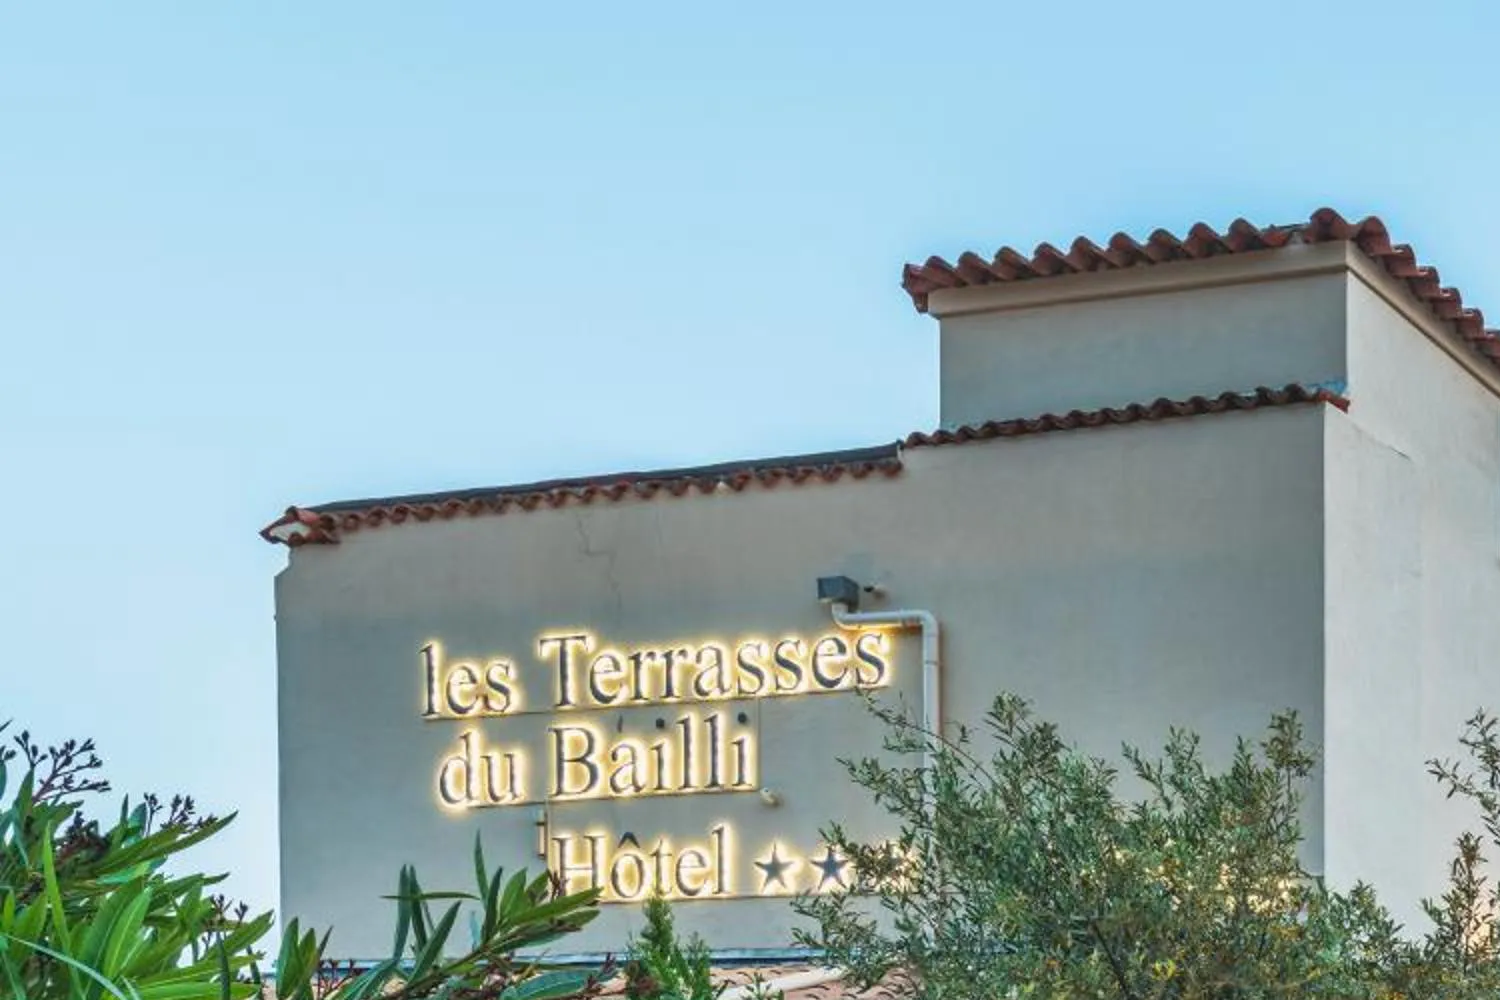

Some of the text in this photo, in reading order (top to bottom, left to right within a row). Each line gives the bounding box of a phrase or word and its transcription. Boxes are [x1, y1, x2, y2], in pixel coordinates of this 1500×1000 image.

[418, 630, 890, 716] les Terrasses
[439, 712, 754, 804] du Bailli
[552, 825, 732, 899] Hôtel
